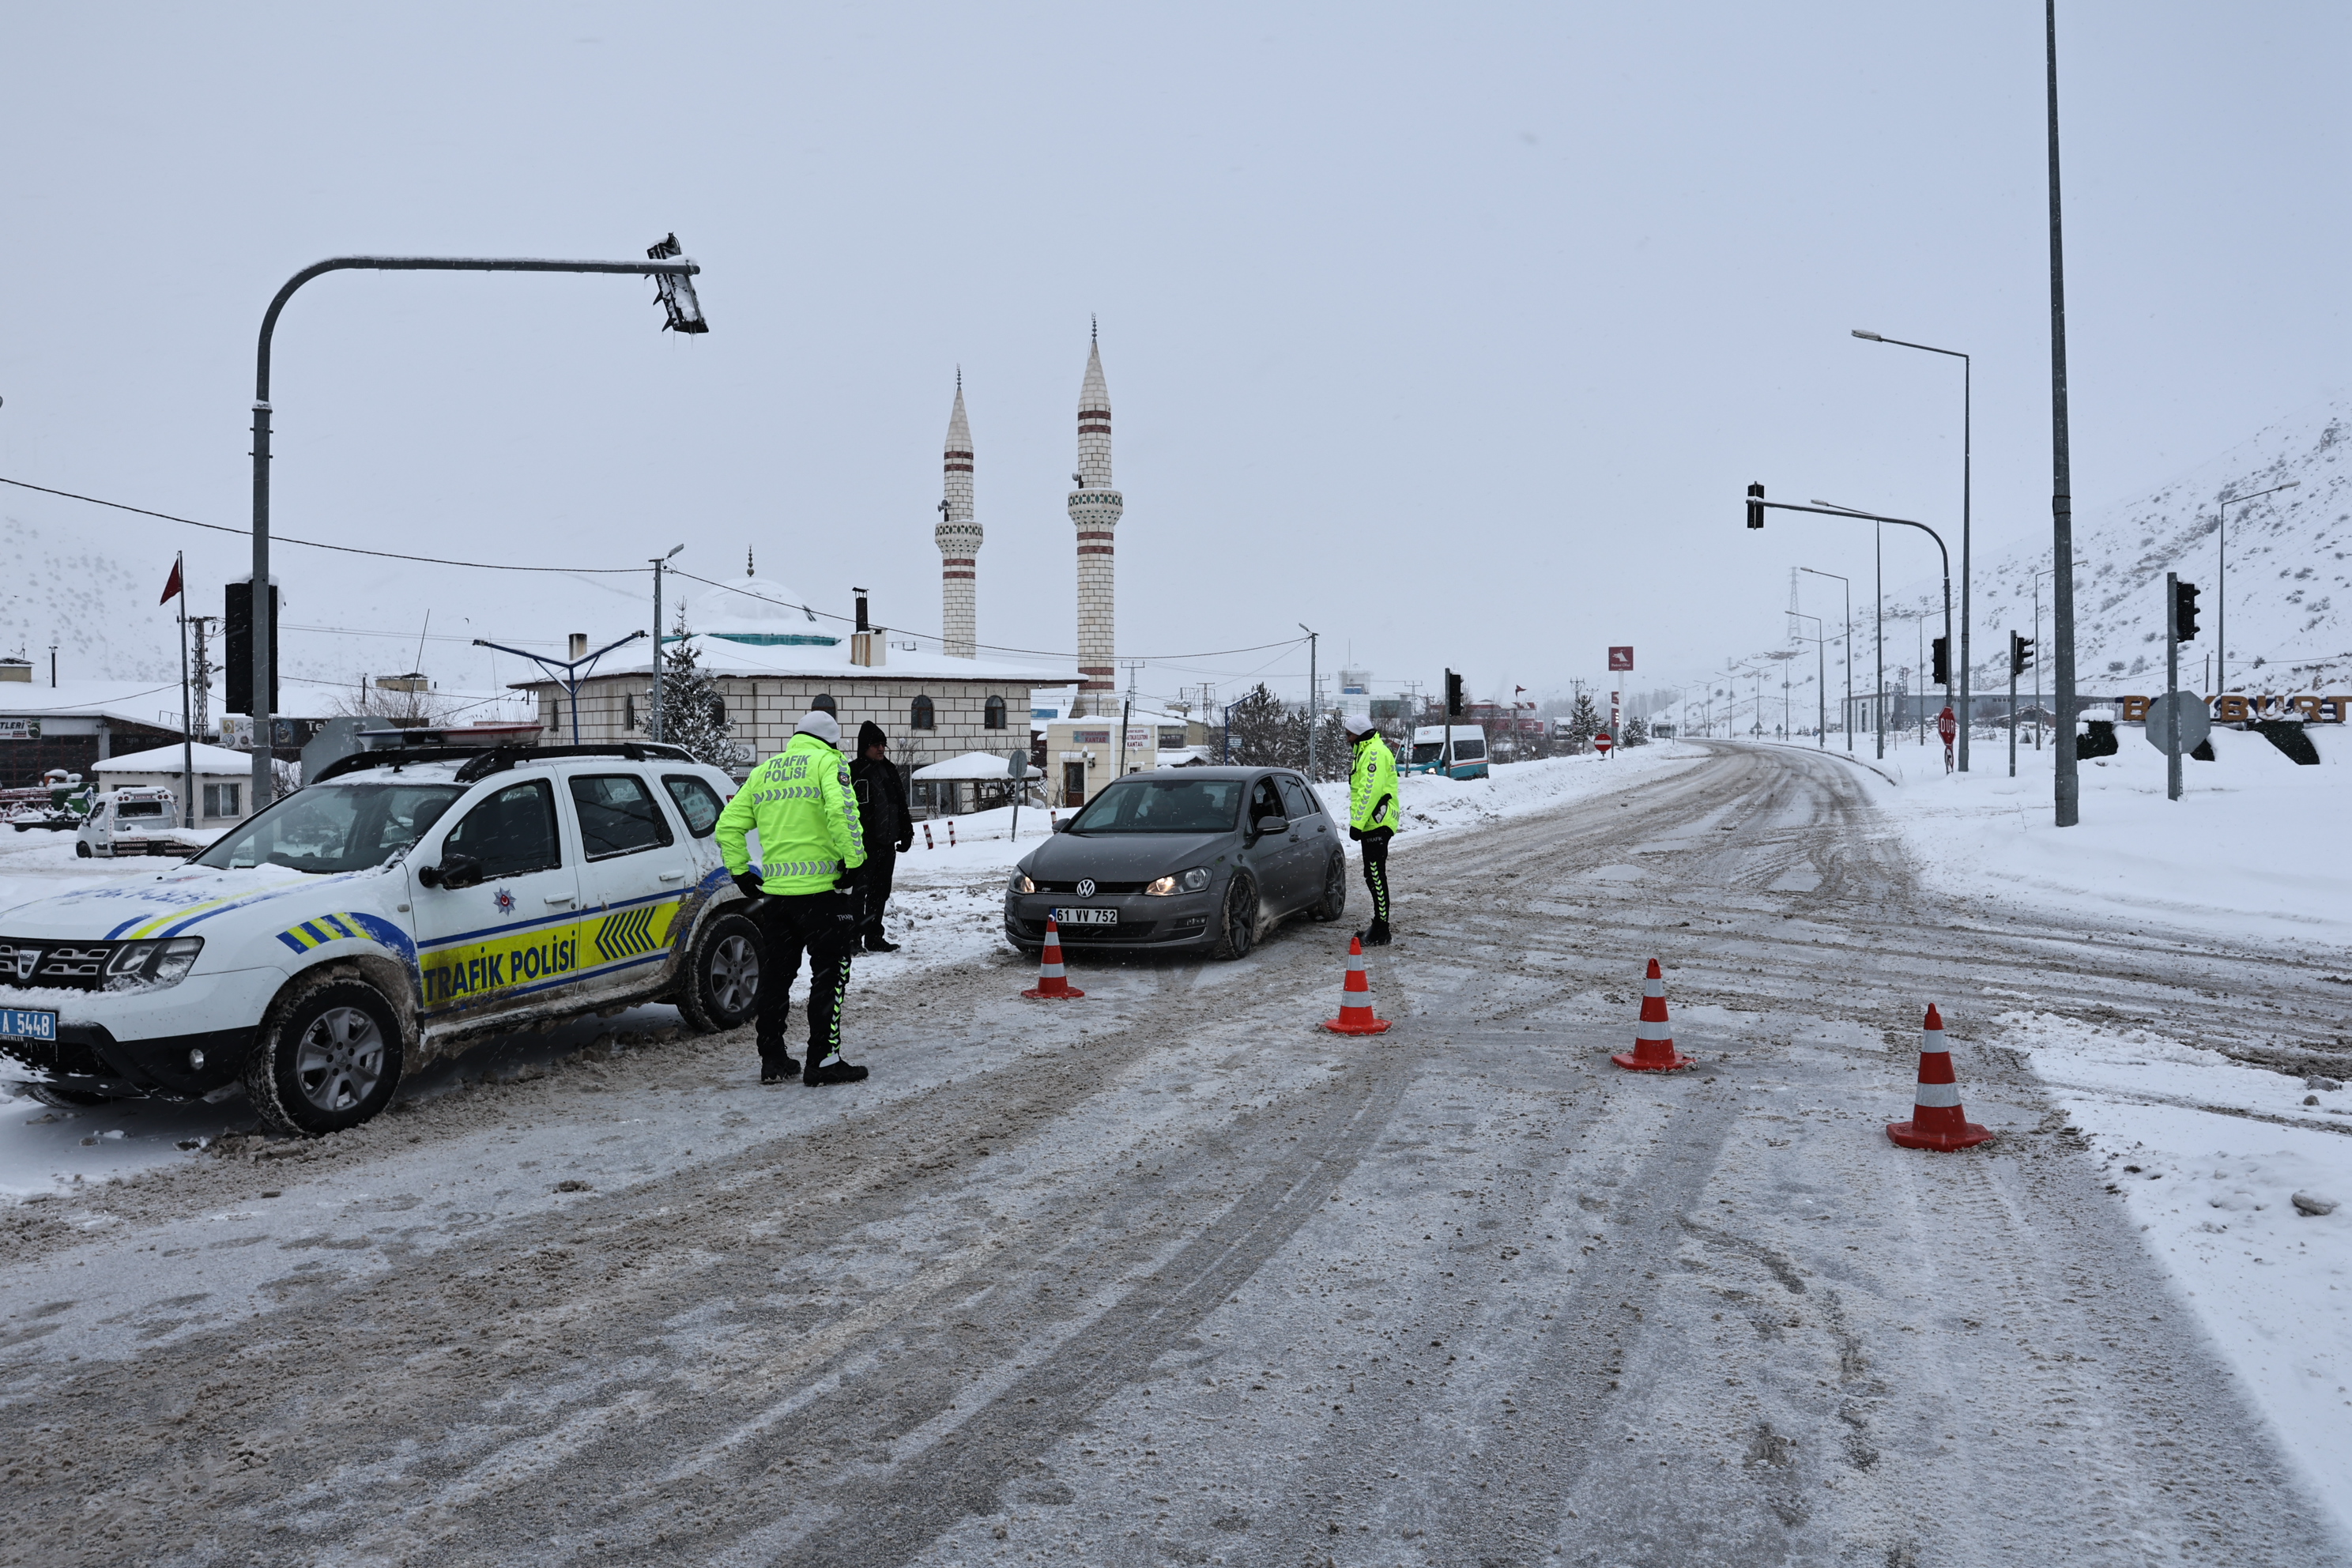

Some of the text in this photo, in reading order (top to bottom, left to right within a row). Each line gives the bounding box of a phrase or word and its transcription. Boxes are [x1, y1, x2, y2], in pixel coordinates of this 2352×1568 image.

[2123, 695, 2352, 721] BBURT
[1940, 718, 1955, 734] DUR
[767, 755, 812, 770] TRAFİK
[763, 767, 807, 783] POLİSİ
[1057, 910, 1116, 922] 61 VV 752
[424, 929, 576, 1002] TRAFİK POLİSİ
[2, 1012, 50, 1036] A 5448
